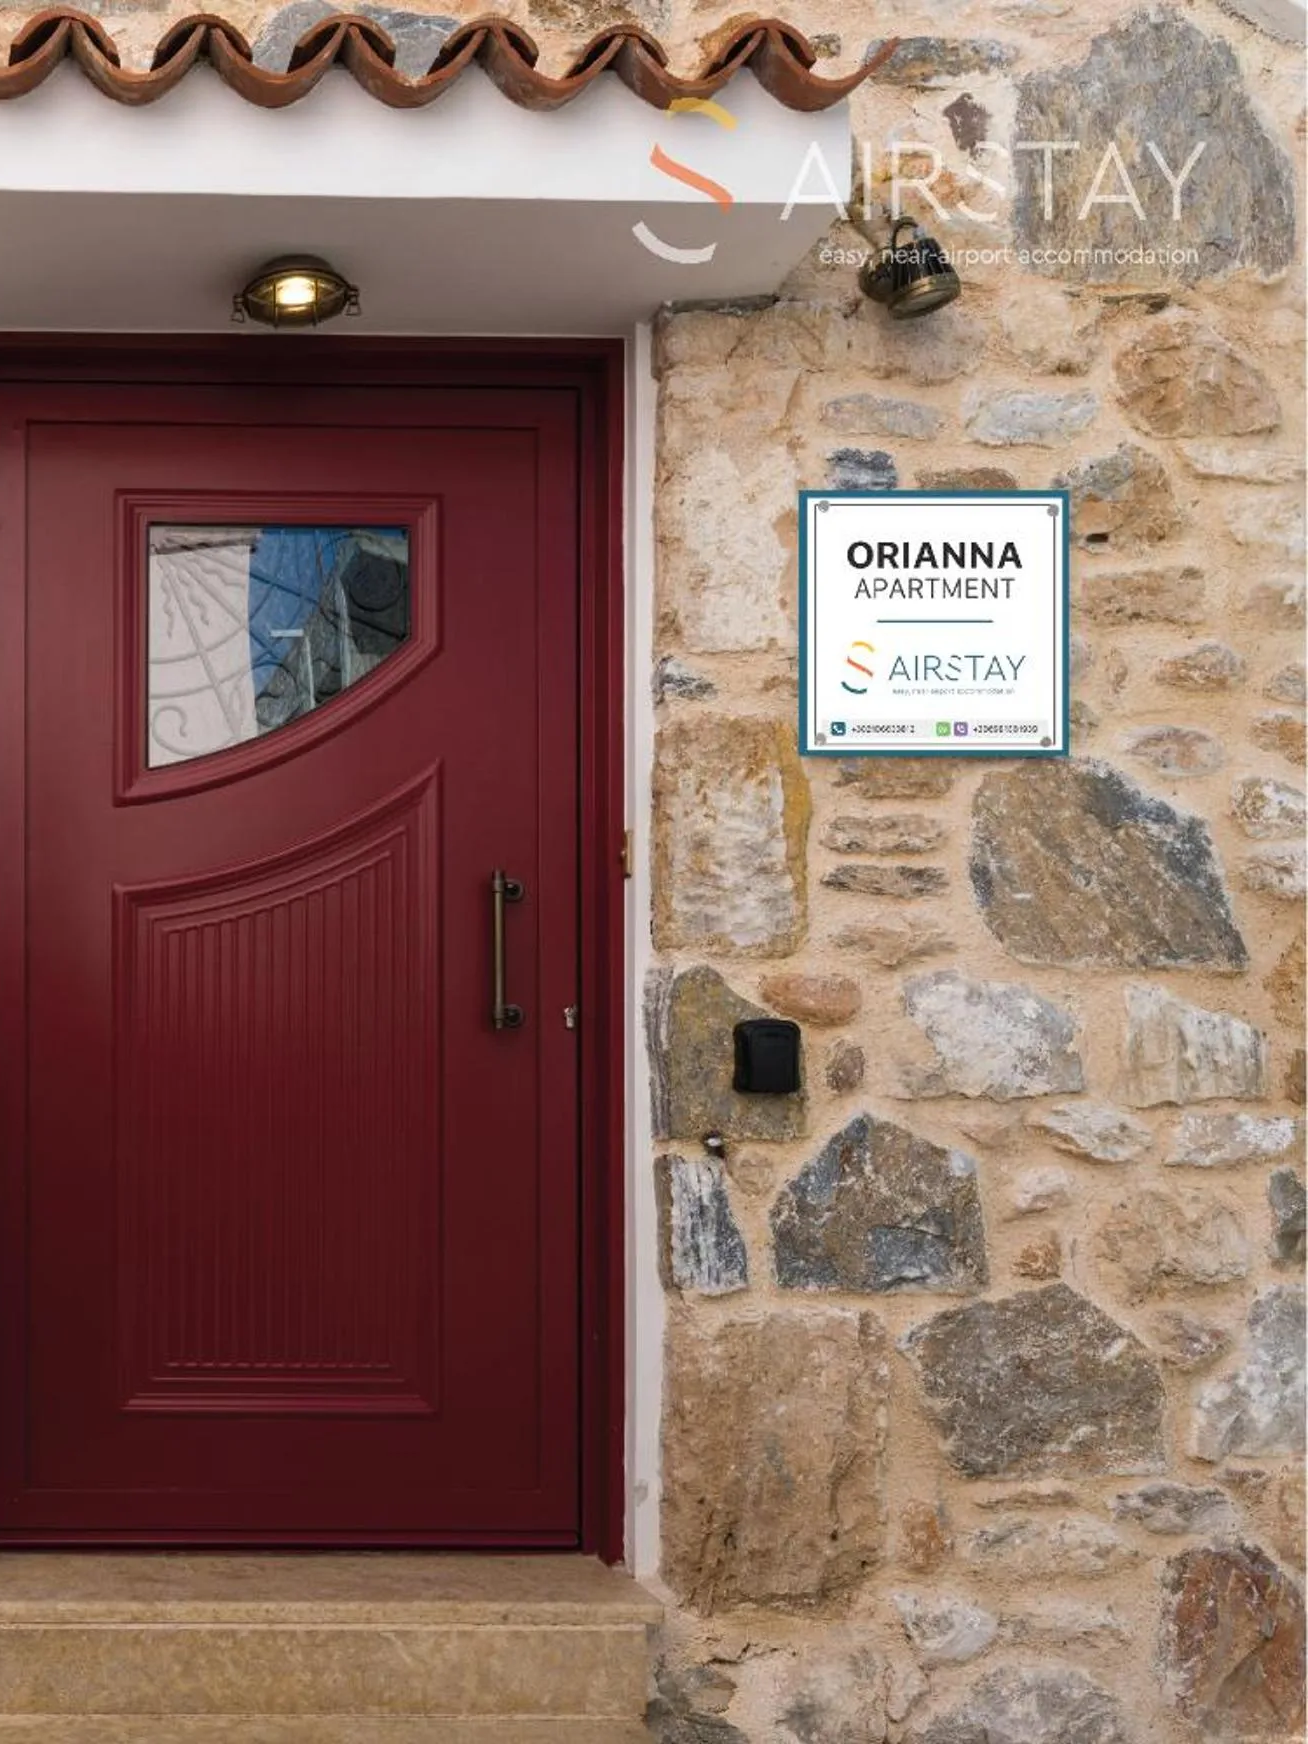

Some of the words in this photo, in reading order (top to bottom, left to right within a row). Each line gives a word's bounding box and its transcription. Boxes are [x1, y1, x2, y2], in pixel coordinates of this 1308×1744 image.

[846, 540, 1023, 570] ORIANNA
[853, 577, 1016, 600] APARTMENT
[888, 654, 1027, 682] AIRSTAY
